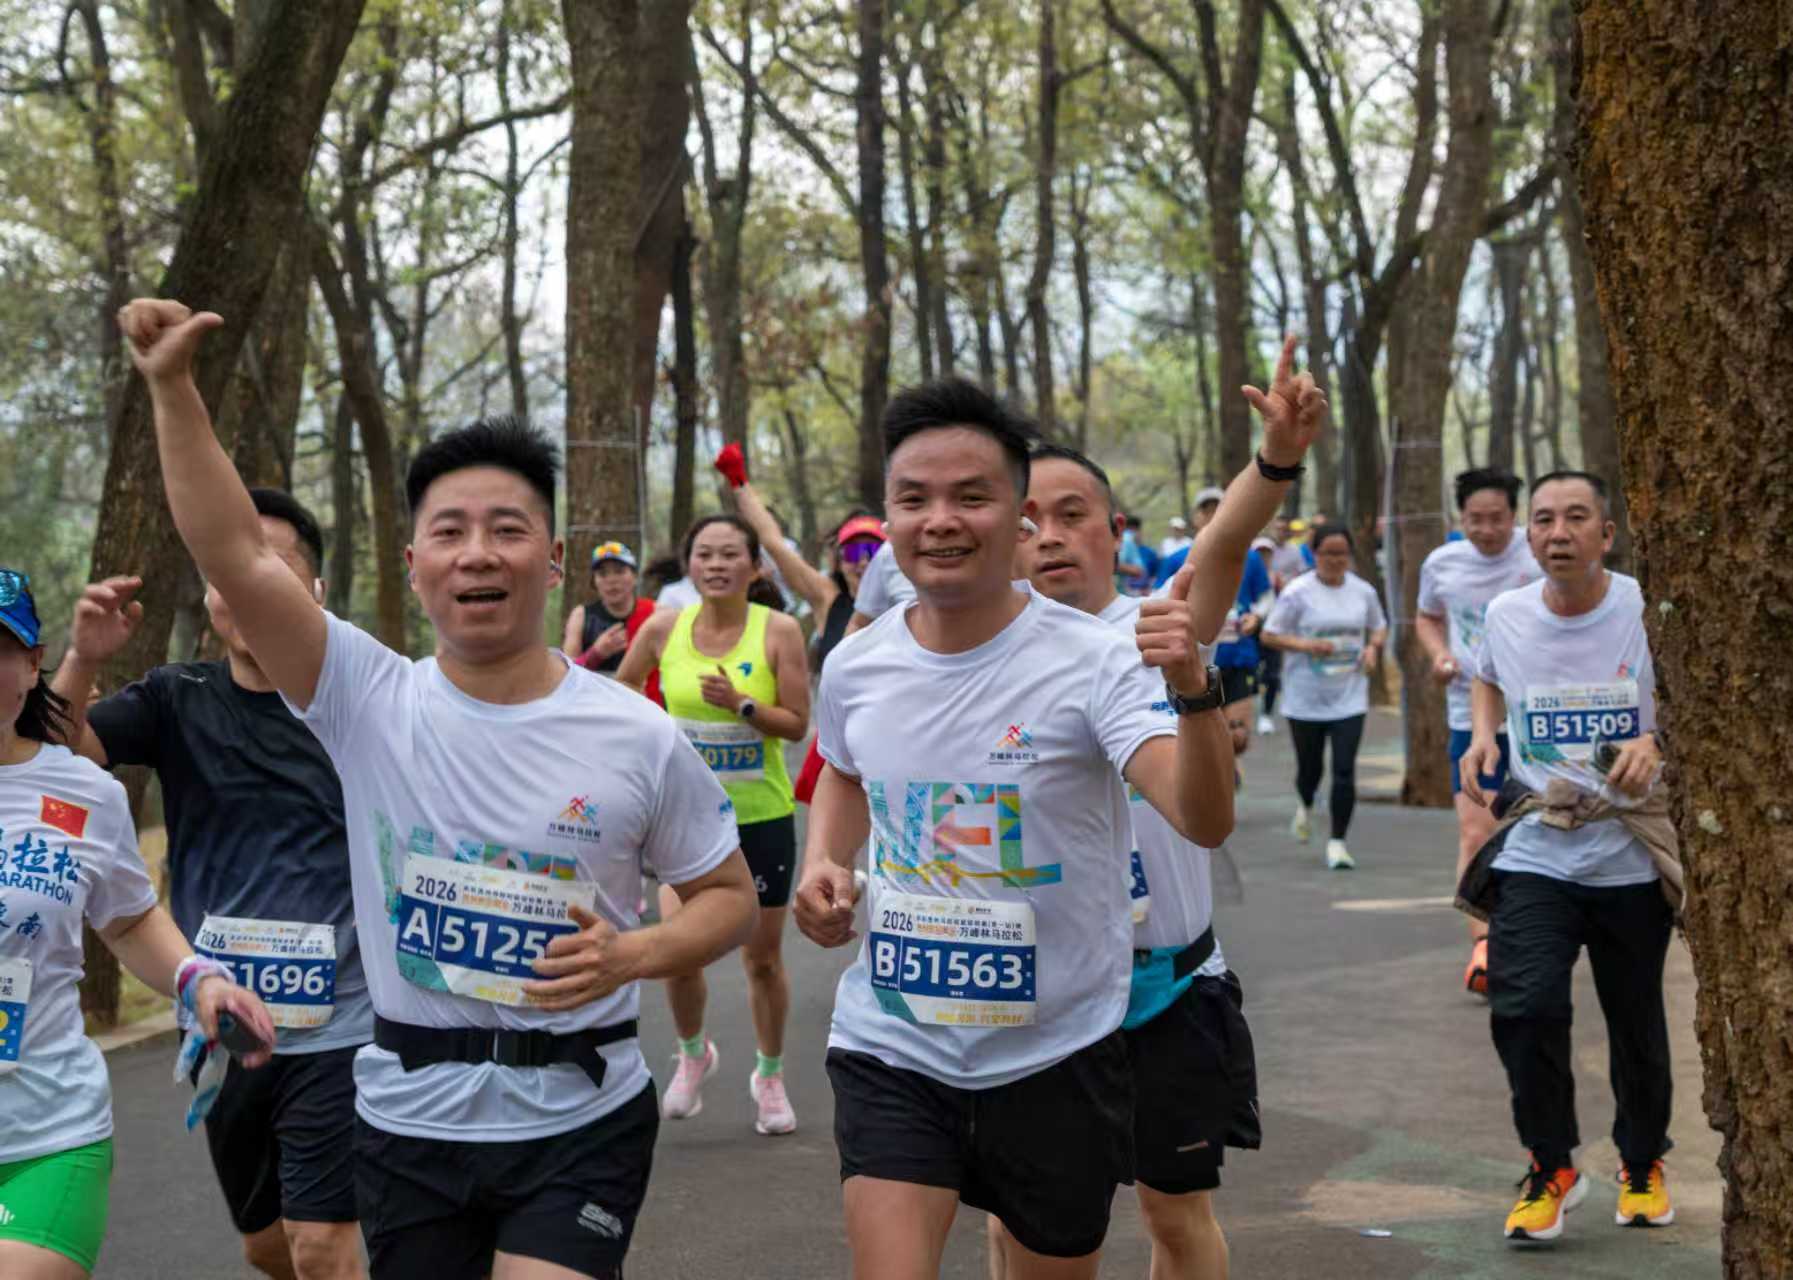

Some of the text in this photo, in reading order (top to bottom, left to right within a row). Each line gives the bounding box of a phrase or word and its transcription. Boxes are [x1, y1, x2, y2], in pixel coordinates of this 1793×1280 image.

[1532, 712, 1632, 738] B 51509
[698, 747, 756, 766] 0179
[415, 875, 458, 902] 2026
[511, 902, 568, 920] 万峰林马拉
[882, 909, 913, 932] 2026
[401, 907, 549, 967] A 5125
[959, 926, 1024, 942] 万峰林马拉松
[223, 961, 325, 995] 1696
[875, 941, 1023, 989] B 51563
